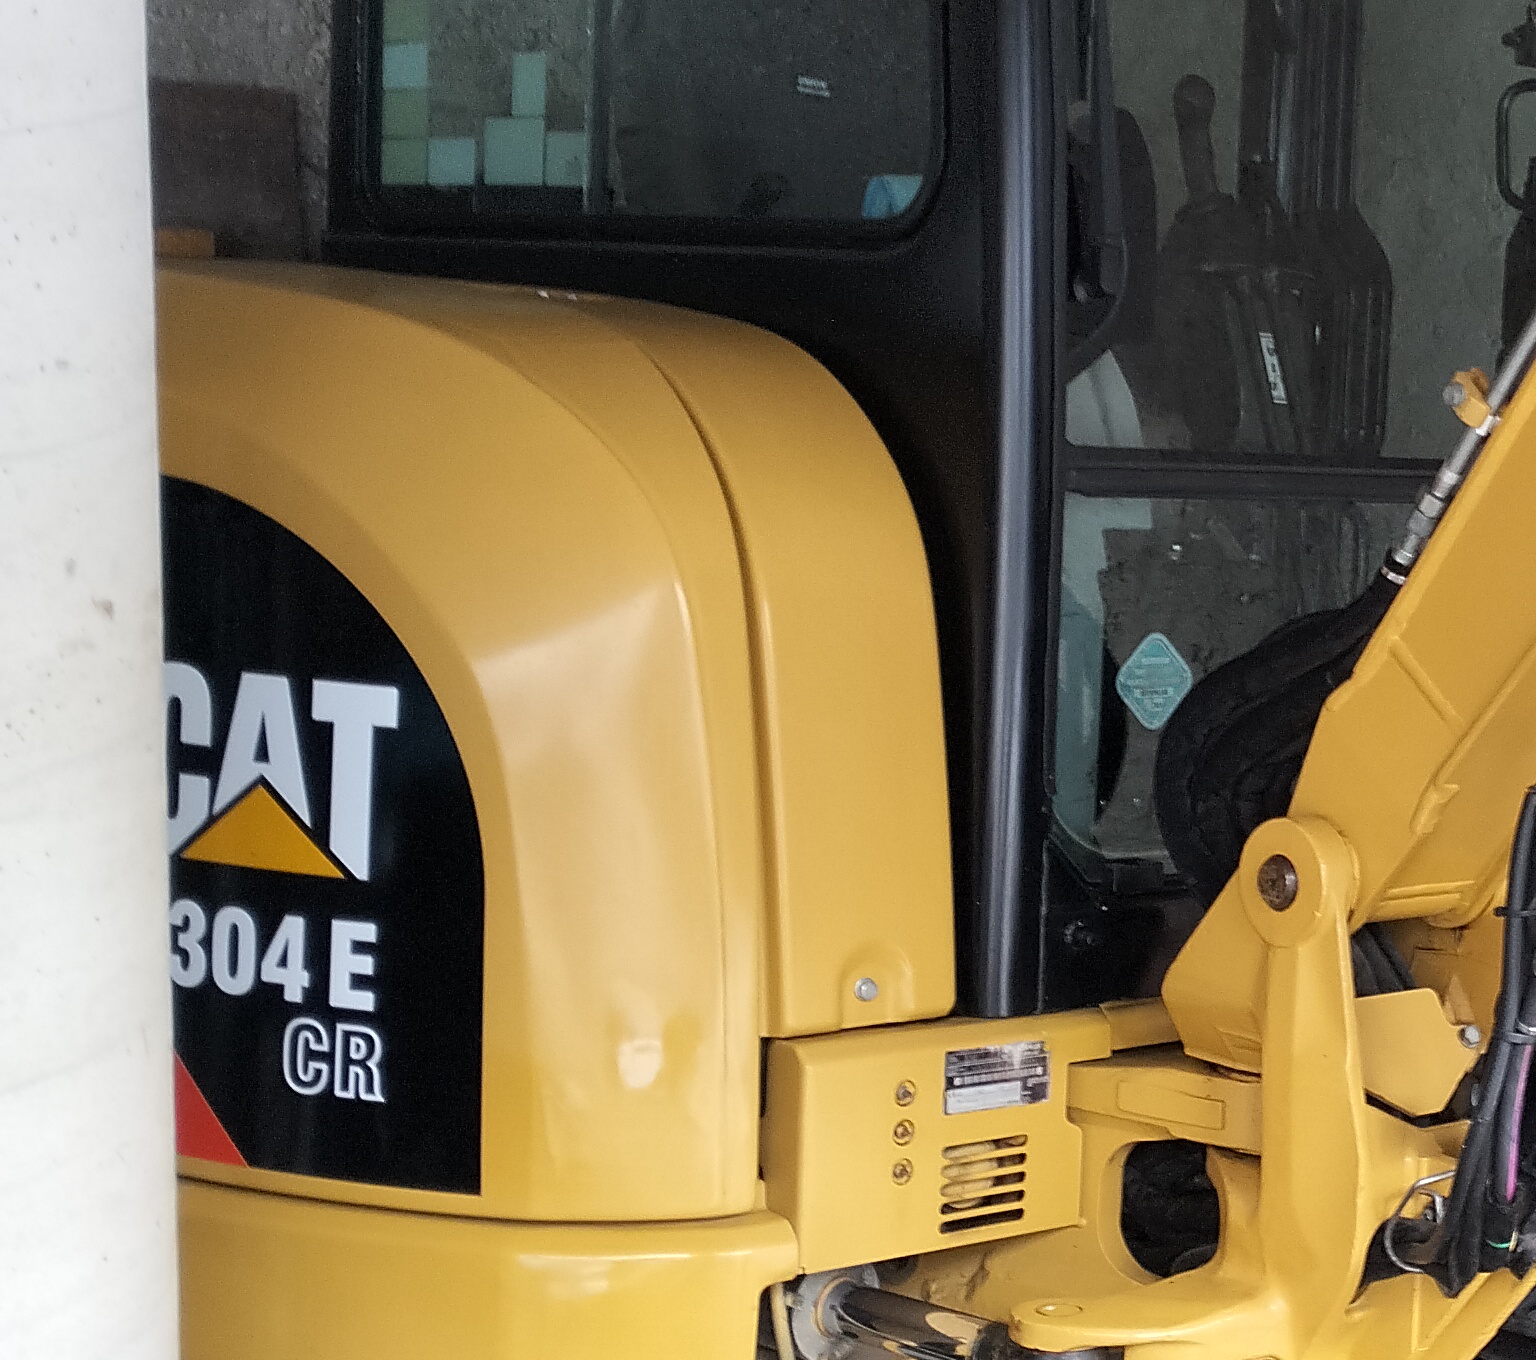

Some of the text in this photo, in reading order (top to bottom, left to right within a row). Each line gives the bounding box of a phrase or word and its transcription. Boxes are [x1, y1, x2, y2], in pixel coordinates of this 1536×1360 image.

[163, 660, 399, 882] CAT
[169, 898, 378, 1013] 304 E
[282, 1016, 386, 1104] CR
